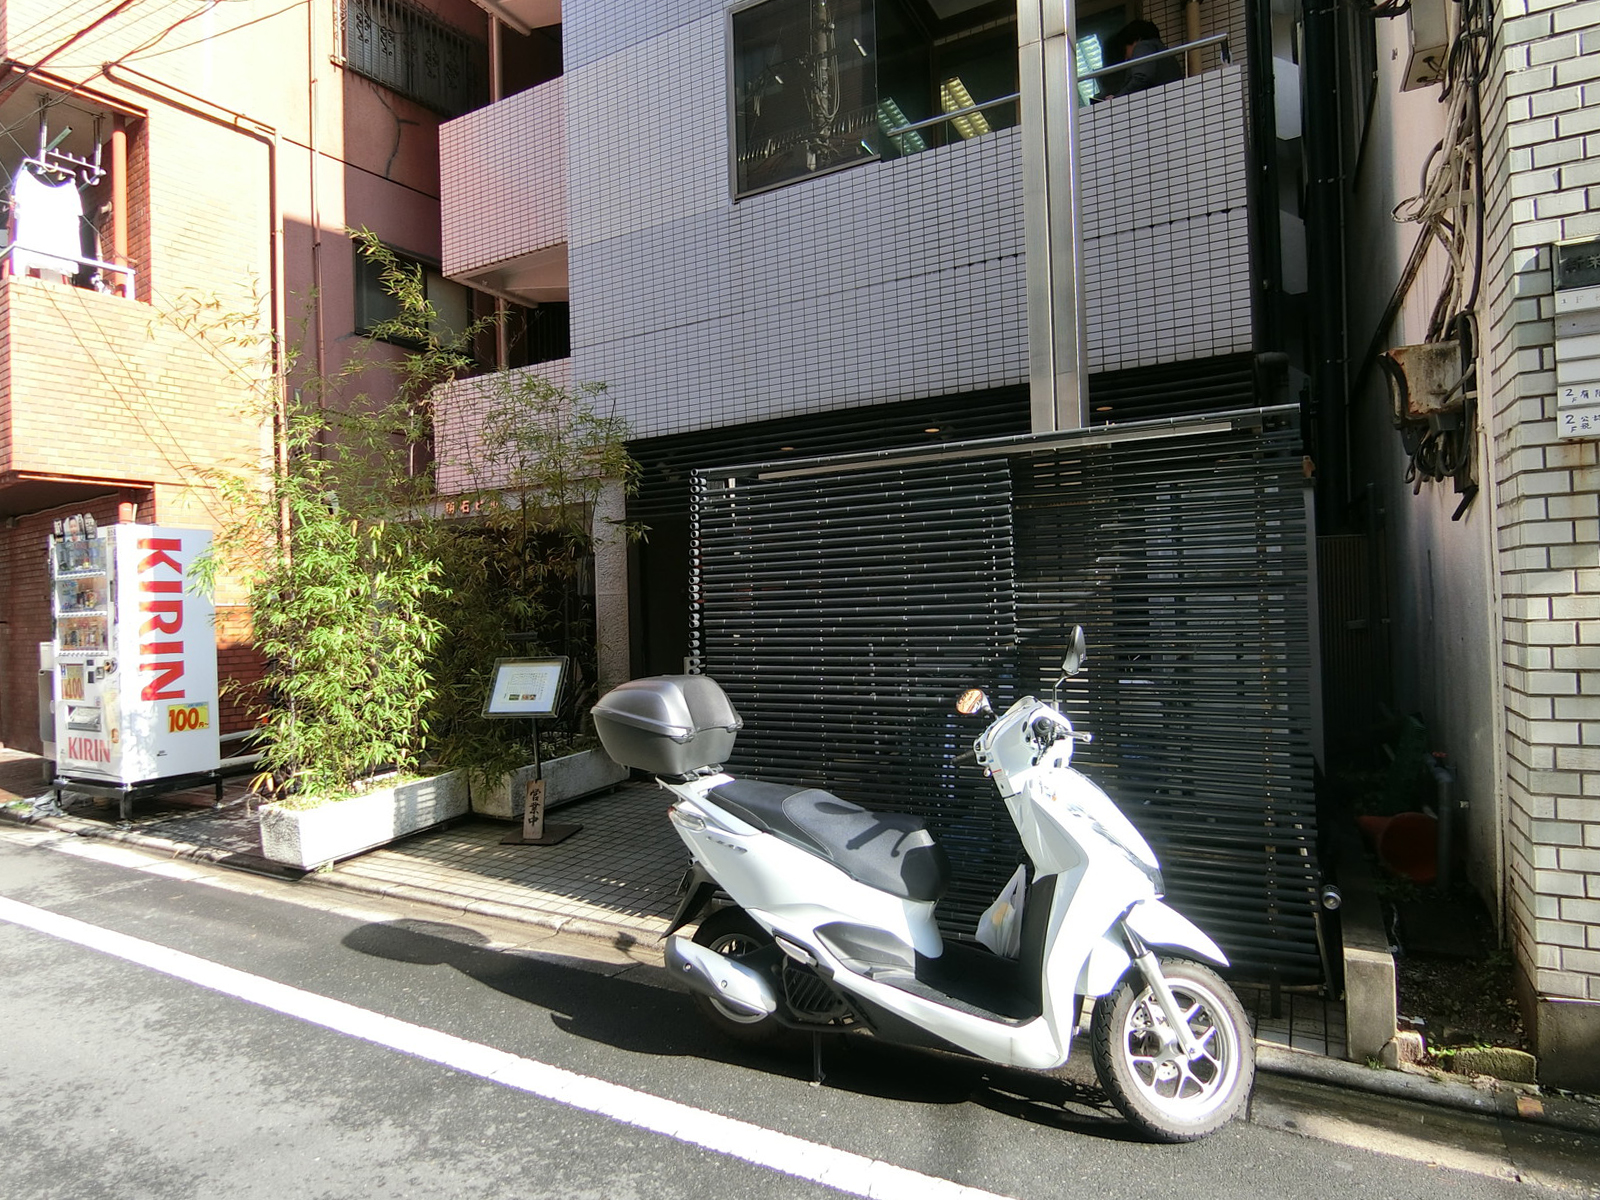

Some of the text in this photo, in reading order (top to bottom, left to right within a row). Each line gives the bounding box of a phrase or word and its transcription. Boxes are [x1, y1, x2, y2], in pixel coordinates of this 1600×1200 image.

[137, 538, 186, 702] KIRIN
[68, 736, 111, 763] KIRIN
[528, 788, 541, 827] 営業中
